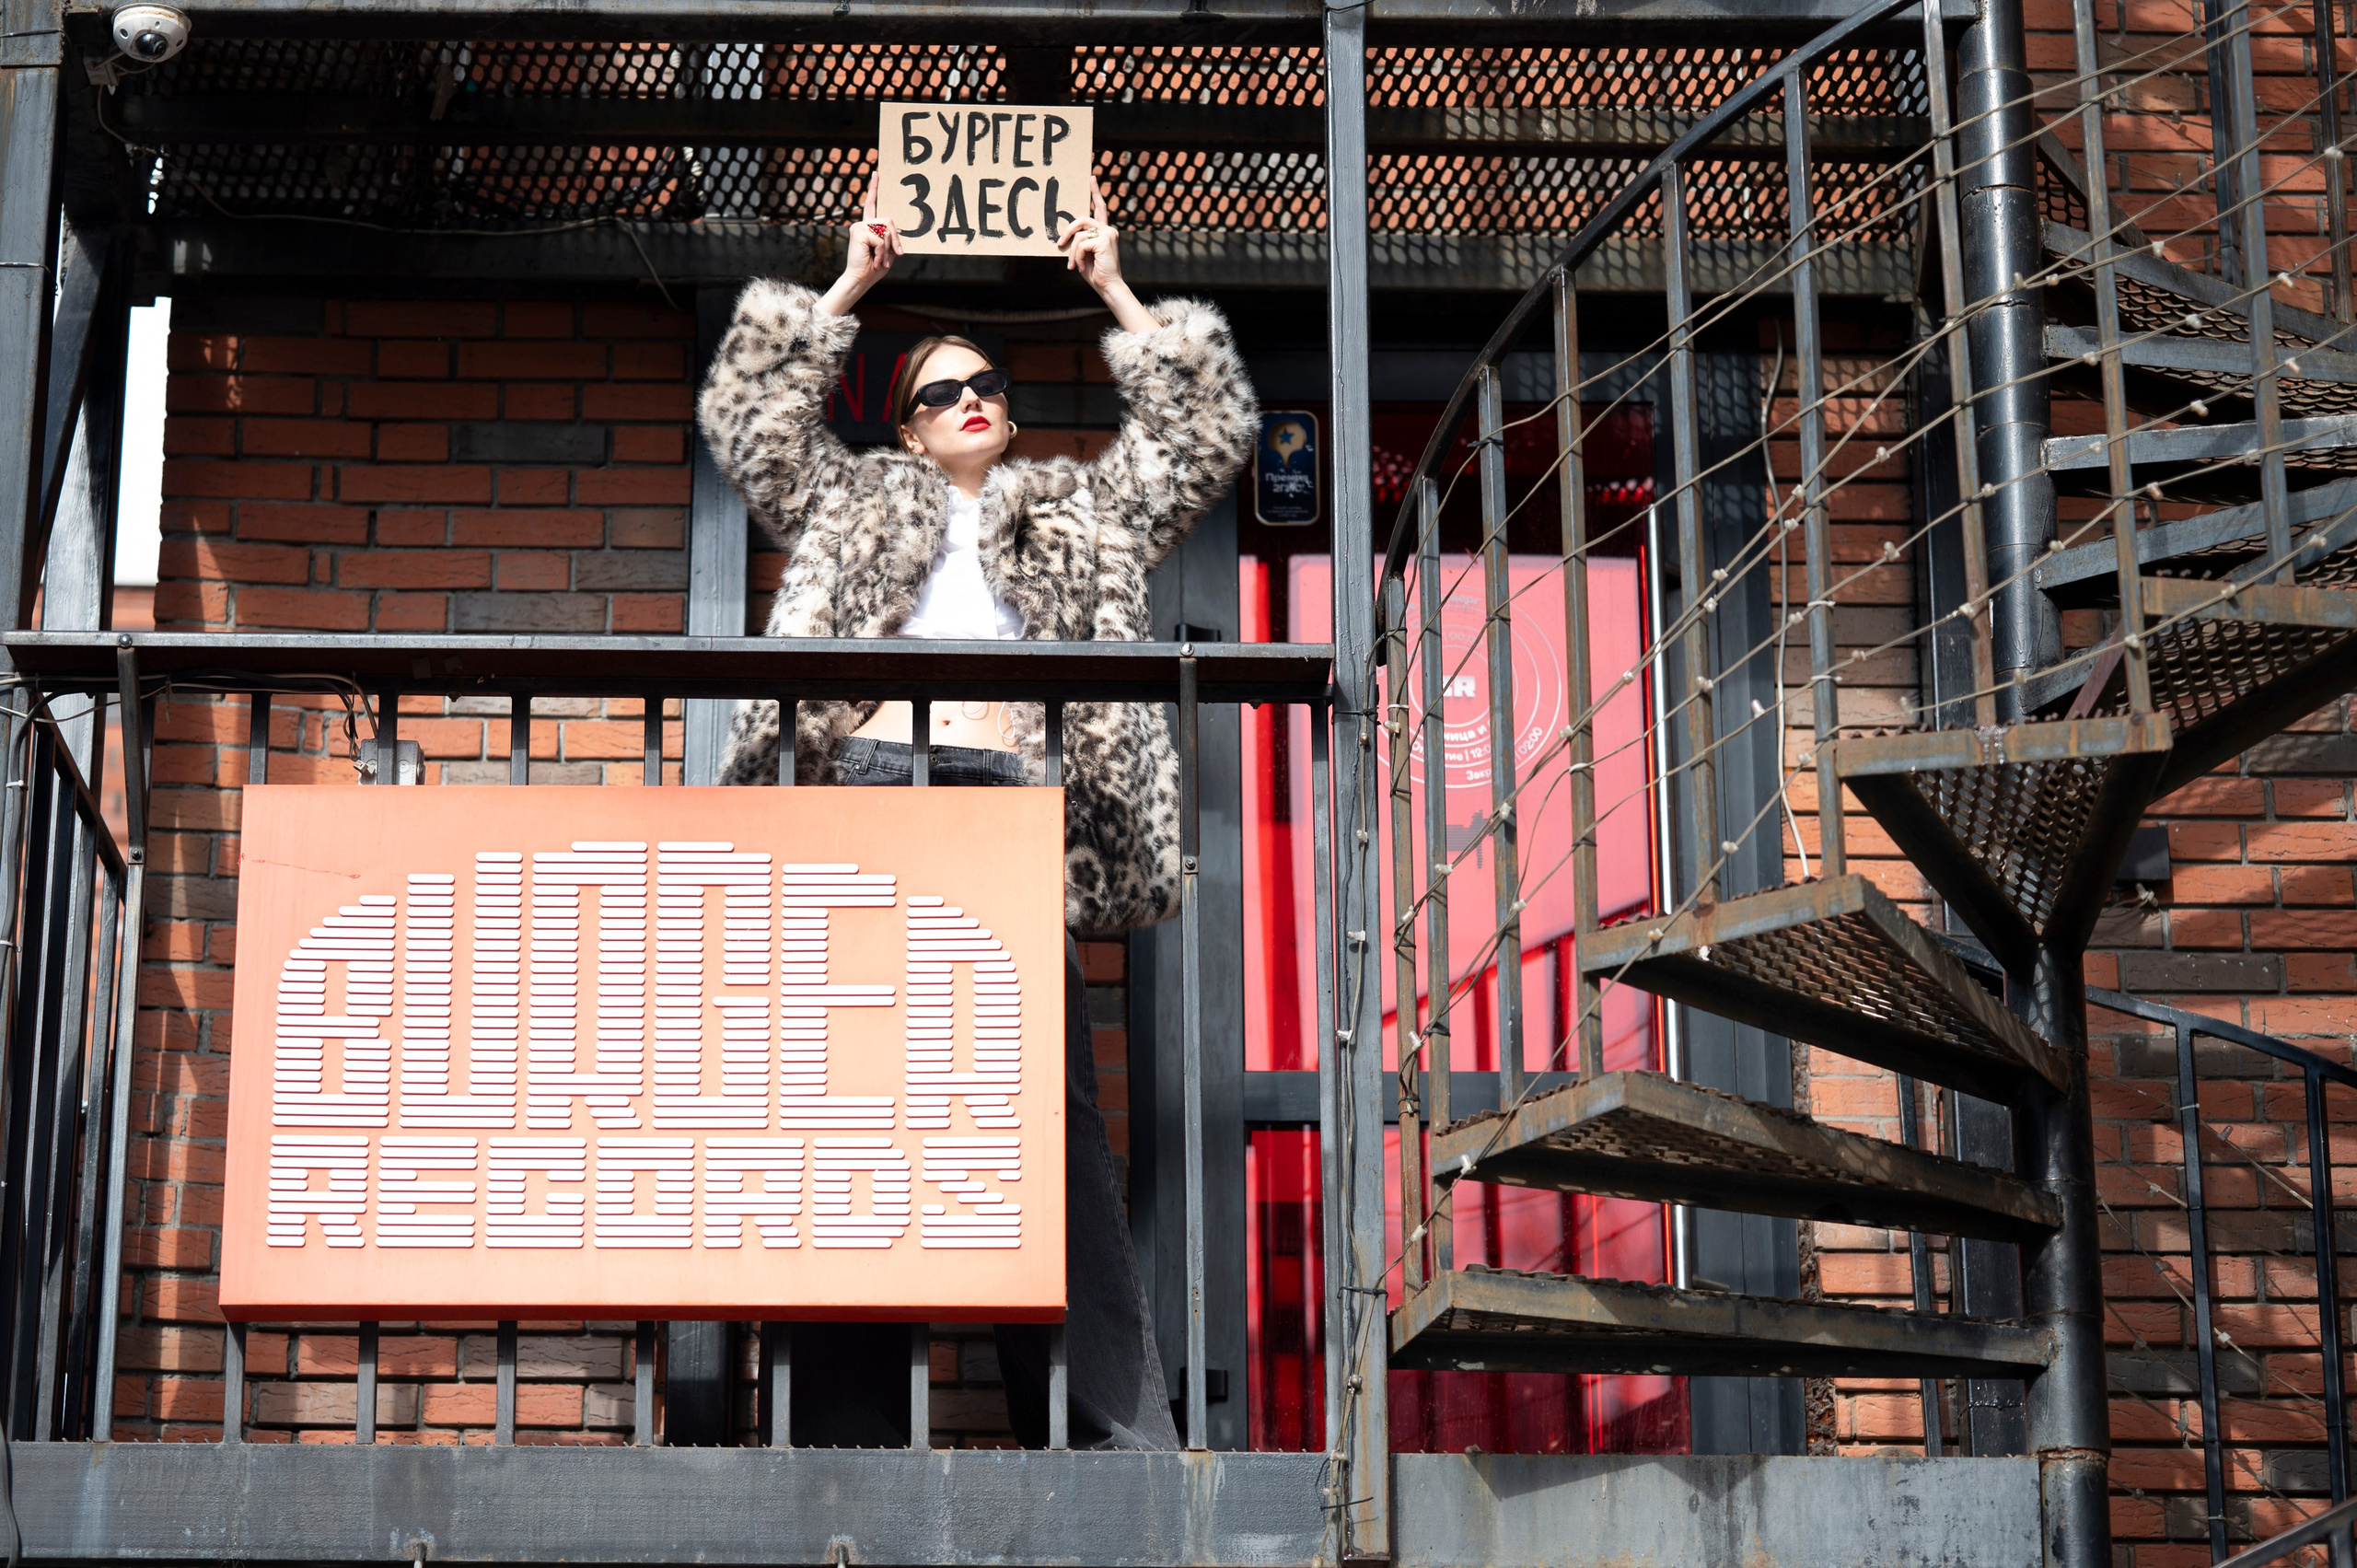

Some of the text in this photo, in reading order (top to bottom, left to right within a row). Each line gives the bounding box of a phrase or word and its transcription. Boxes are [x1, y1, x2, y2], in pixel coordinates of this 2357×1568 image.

[901, 111, 1071, 168] БУРГЕР
[897, 173, 1075, 245] ЗДЕСЬ
[272, 841, 1021, 1129] BURGER
[266, 1135, 1021, 1249] RECORDS
